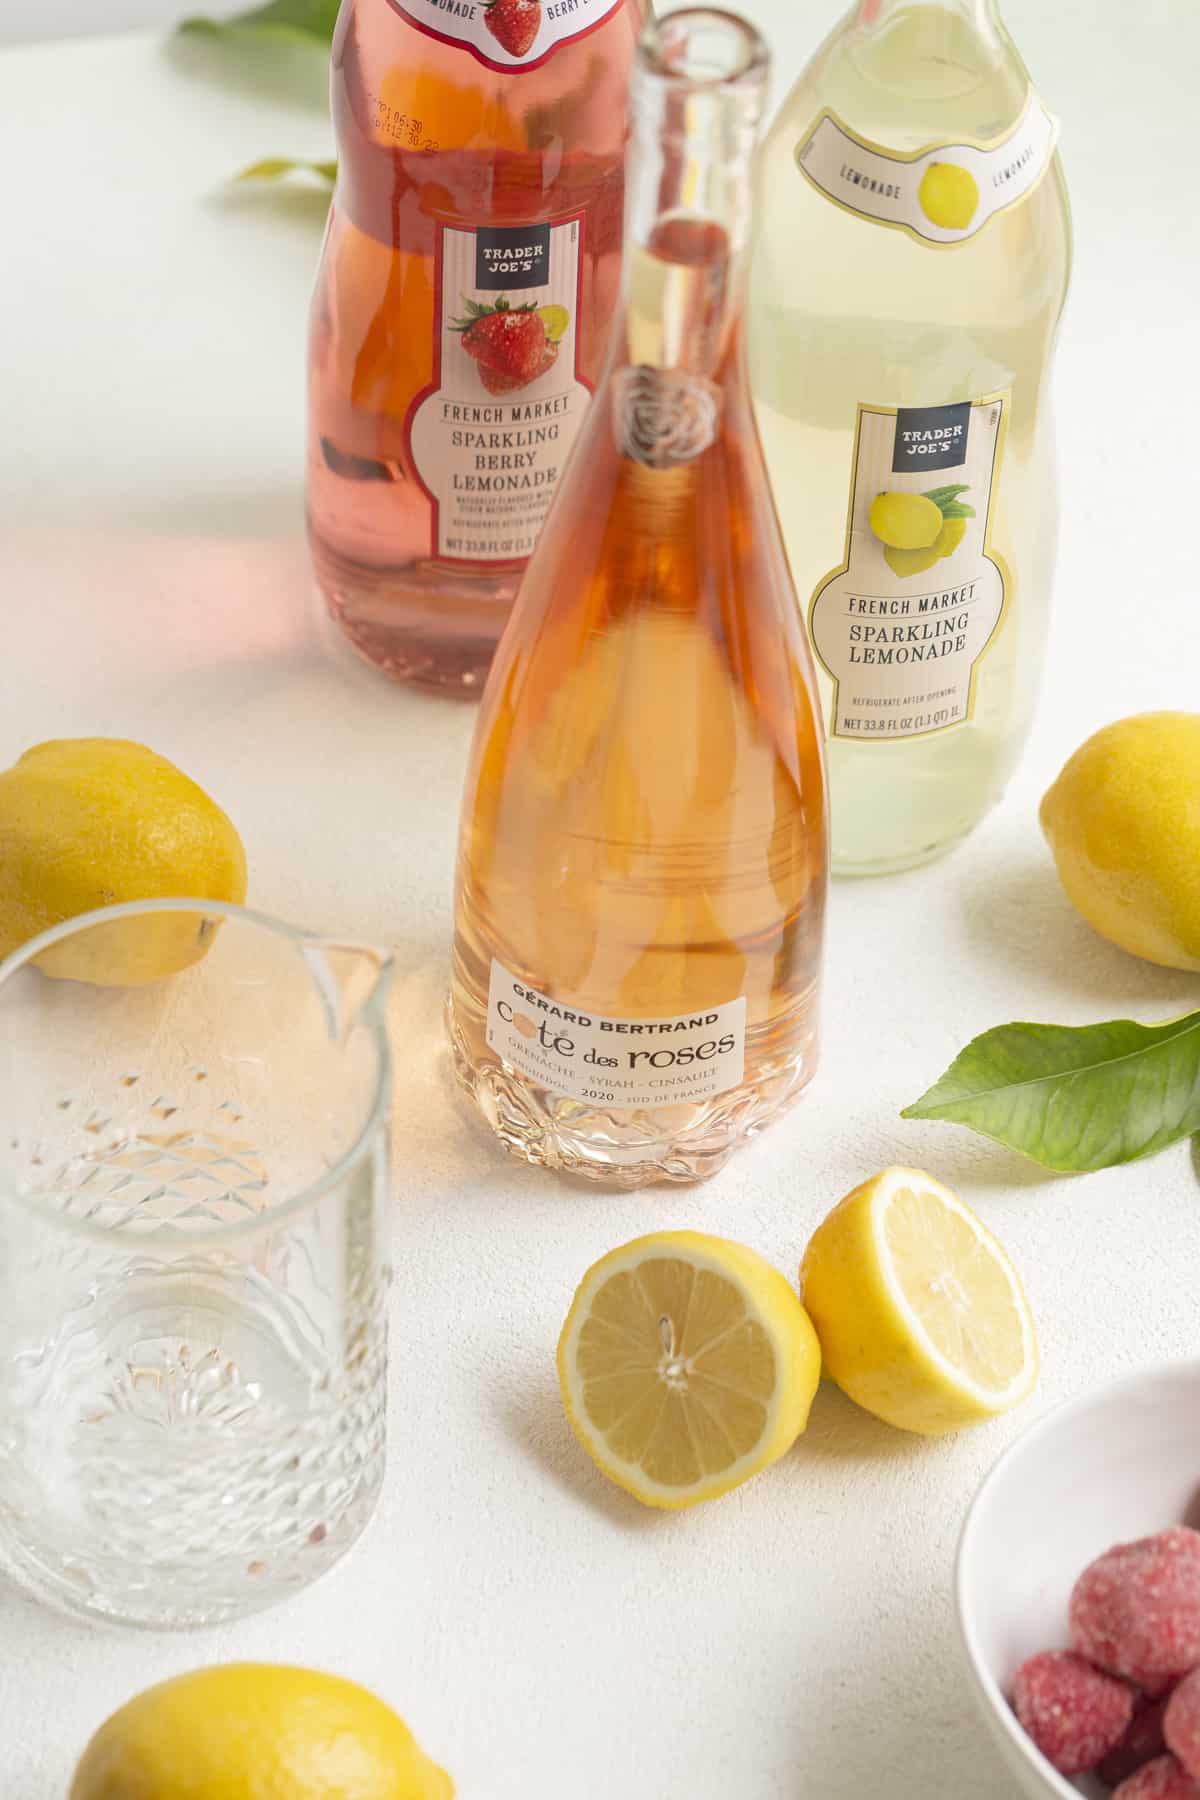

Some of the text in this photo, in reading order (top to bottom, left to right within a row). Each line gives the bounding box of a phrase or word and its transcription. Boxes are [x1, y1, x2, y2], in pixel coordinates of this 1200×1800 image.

[427, 0, 477, 20] ONADE
[992, 144, 1034, 188] LEMONADE
[840, 164, 901, 200] LEMONADE
[483, 245, 544, 259] TRADER
[488, 259, 533, 273] JOE'S
[443, 396, 569, 423] FRENCH MARKET
[452, 424, 560, 449] SPARKLING
[902, 425, 962, 442] TRADER
[906, 440, 951, 455] JOE'S
[475, 451, 537, 470] BERRY
[453, 468, 558, 492] LEMONADE
[849, 584, 975, 614] FRENCH MARKET
[849, 612, 969, 643] SPARKLING
[850, 634, 966, 665] LEMONADE
[852, 686, 957, 707] REFRIGERATE AFTER OPENING
[843, 718, 861, 730] NET
[863, 719, 885, 730] 33.8
[887, 719, 897, 730] FL
[900, 718, 913, 729] OZ
[513, 983, 719, 1035] GÉRARD BERTRAND
[507, 1036, 576, 1078] GRENACHE
[589, 1074, 635, 1089] SYRAH
[583, 1047, 619, 1068] des
[627, 1033, 735, 1069] roses
[581, 1088, 615, 1101] 2020
[654, 1093, 668, 1103] DE
[674, 1083, 717, 1100] FRANCE
